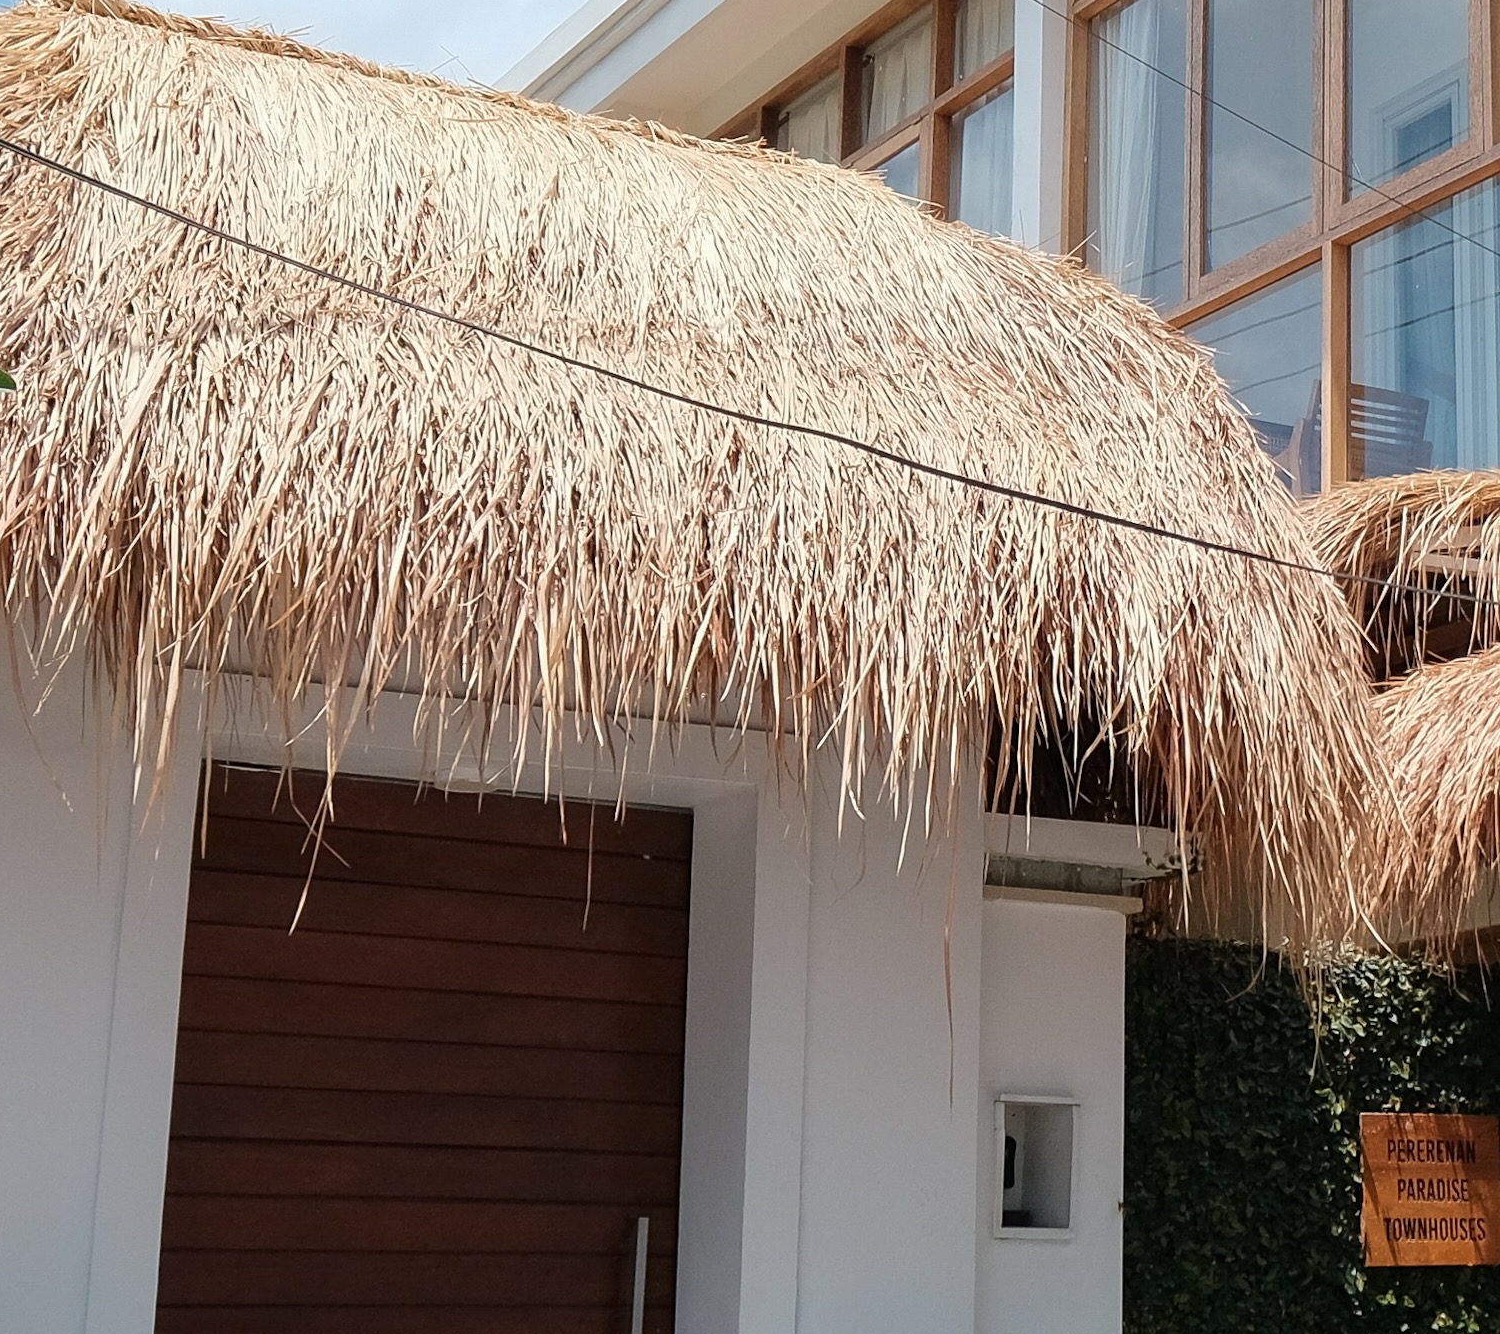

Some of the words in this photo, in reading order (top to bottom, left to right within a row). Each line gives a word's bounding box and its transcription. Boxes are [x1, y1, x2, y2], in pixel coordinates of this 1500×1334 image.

[1387, 1138, 1476, 1163] PERERENAN
[1397, 1178, 1469, 1202] PARADISE
[1383, 1217, 1486, 1242] TOWNHOUSES
